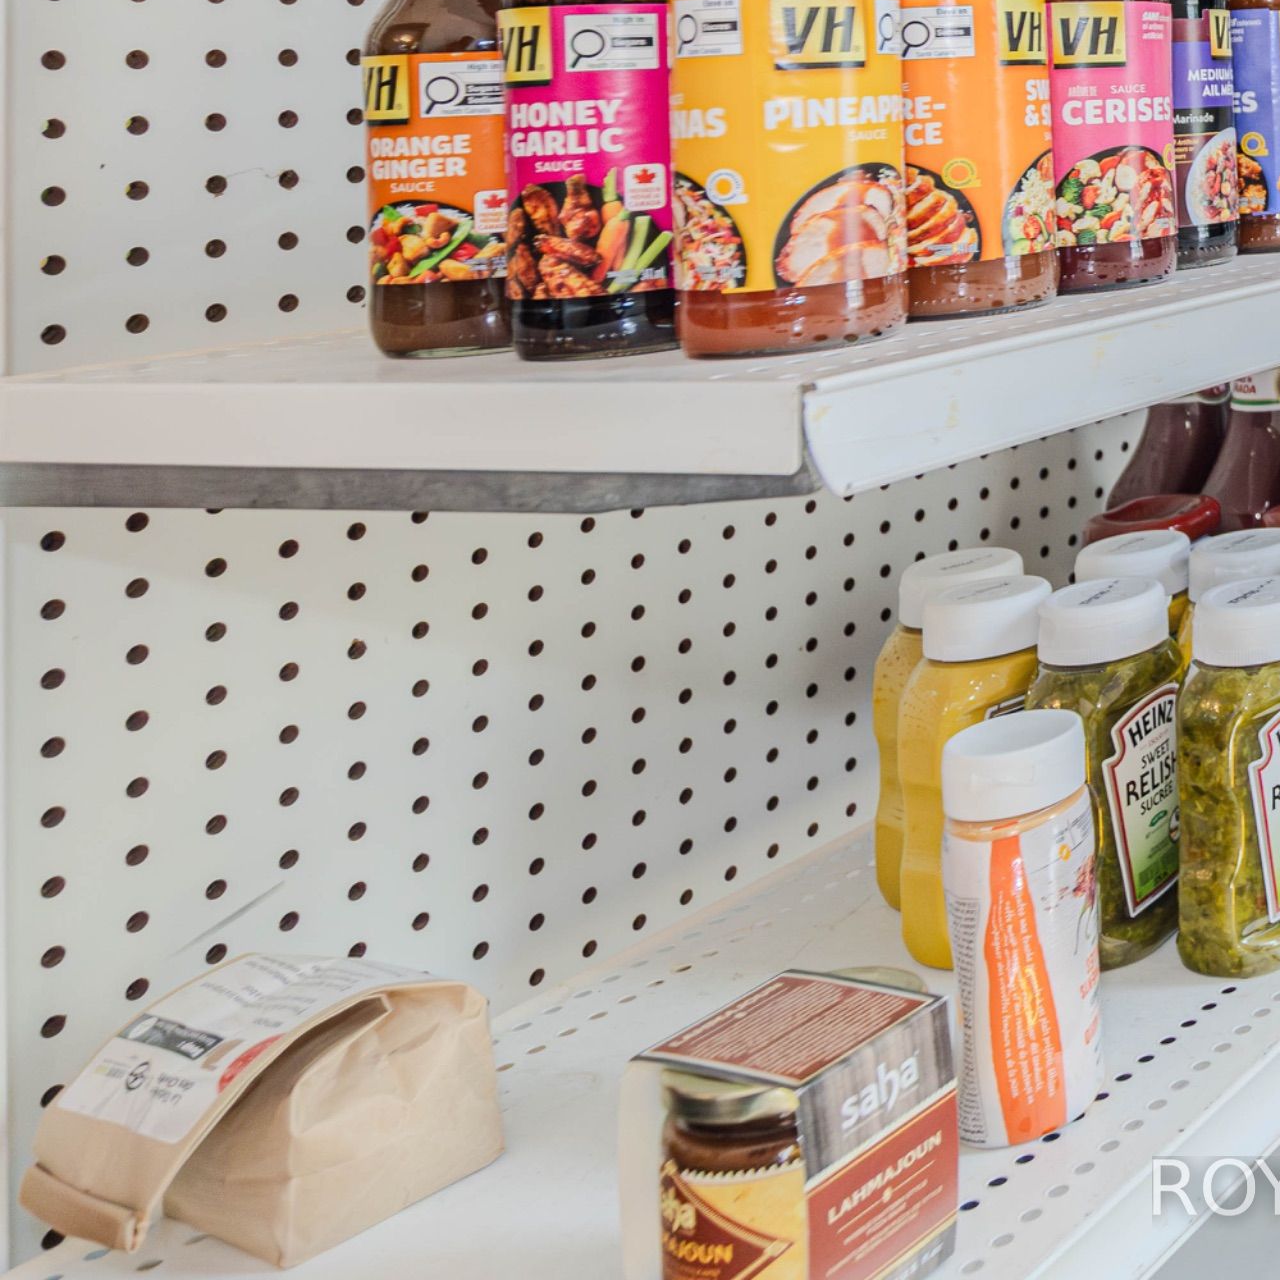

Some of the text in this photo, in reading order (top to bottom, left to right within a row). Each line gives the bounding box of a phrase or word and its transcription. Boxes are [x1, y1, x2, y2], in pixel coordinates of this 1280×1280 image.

[781, 5, 857, 55] VH
[1004, 11, 1042, 53] VH
[1060, 16, 1118, 56] VH
[1110, 83, 1147, 95] SAUCE
[511, 99, 624, 130] HONEY
[1061, 95, 1171, 126] CERISES
[370, 134, 471, 158] ORANGE
[511, 127, 625, 158] GARLIC
[848, 128, 888, 142] SAUCE
[372, 157, 467, 180] GINGER
[534, 159, 585, 174] SAUCE
[391, 181, 435, 194] SAUCE
[1128, 699, 1174, 747] HEINZ
[1141, 738, 1170, 770] SWEET
[840, 1053, 920, 1132] saha
[827, 1130, 943, 1225] LAHMAJOUN
